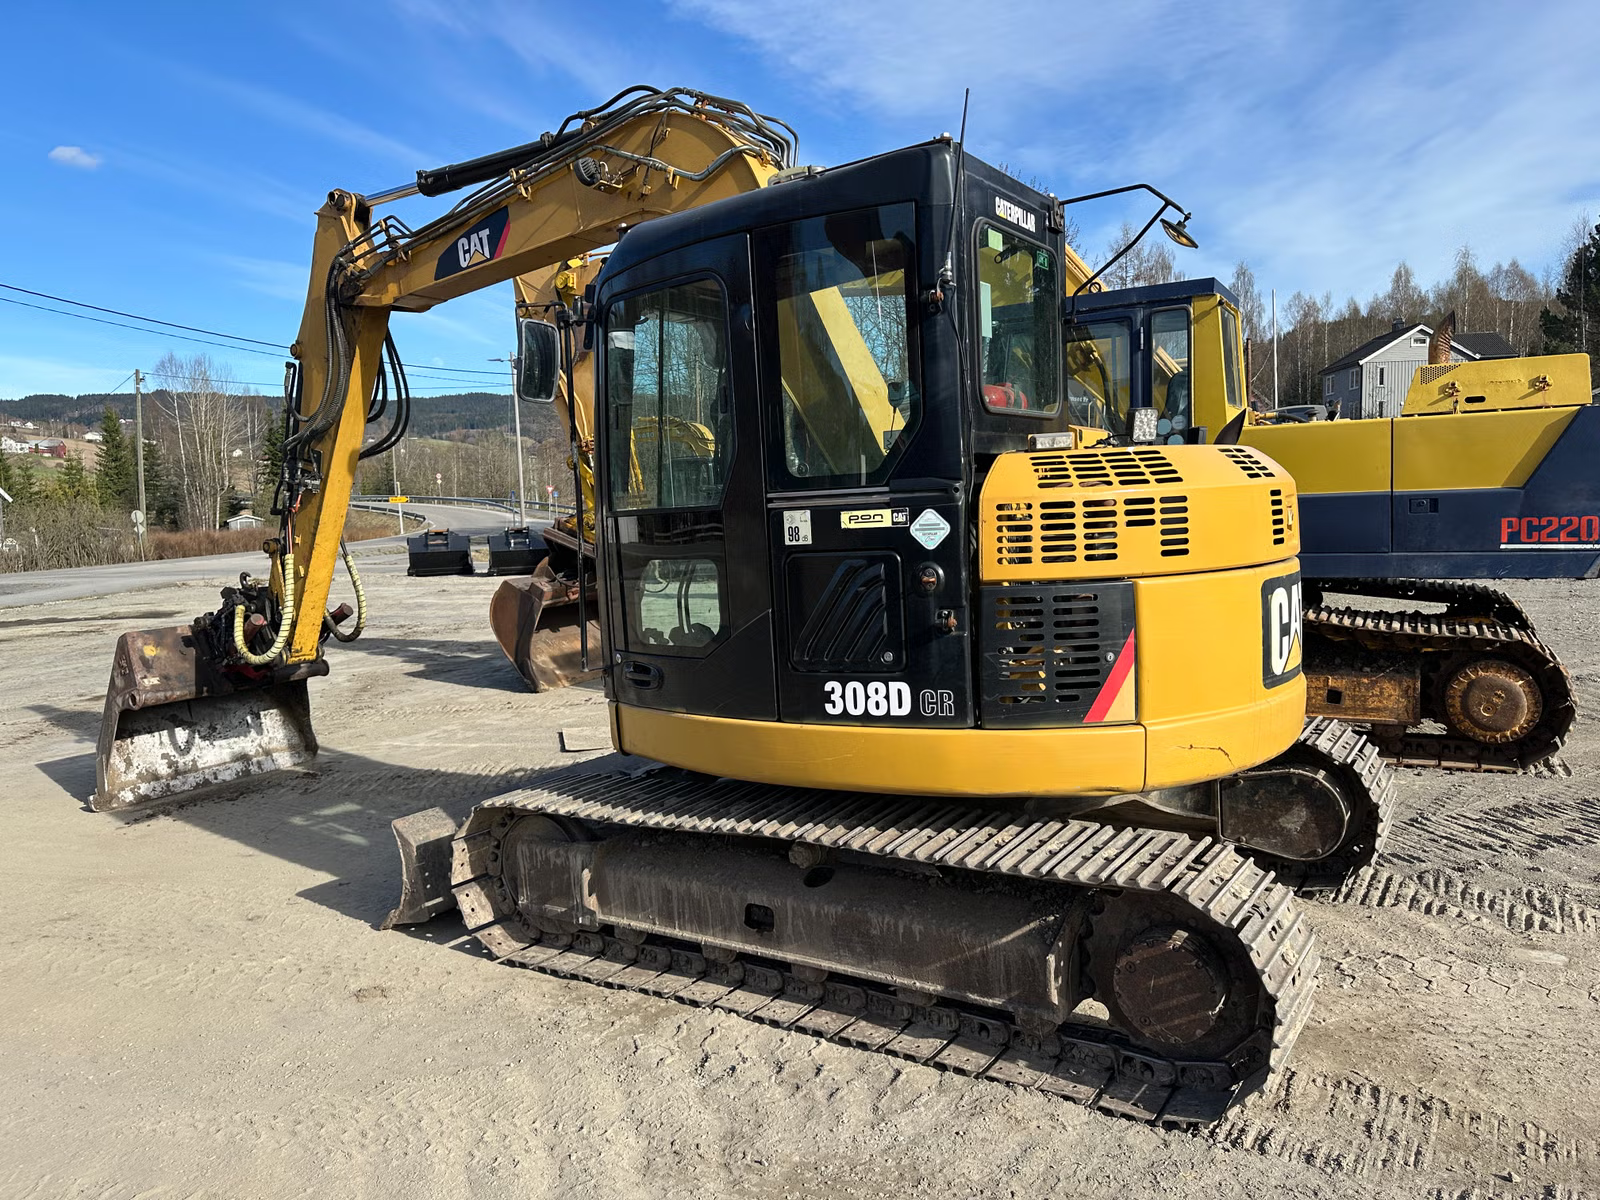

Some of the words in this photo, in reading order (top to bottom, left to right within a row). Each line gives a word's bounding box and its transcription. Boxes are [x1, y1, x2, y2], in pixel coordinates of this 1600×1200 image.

[995, 196, 1036, 233] CATERPILLAR
[457, 227, 490, 268] CAT
[893, 512, 907, 522] CAT
[1501, 515, 1599, 543] PC220
[788, 526, 800, 542] 98
[824, 680, 912, 716] 308D
[919, 689, 955, 716] CR
